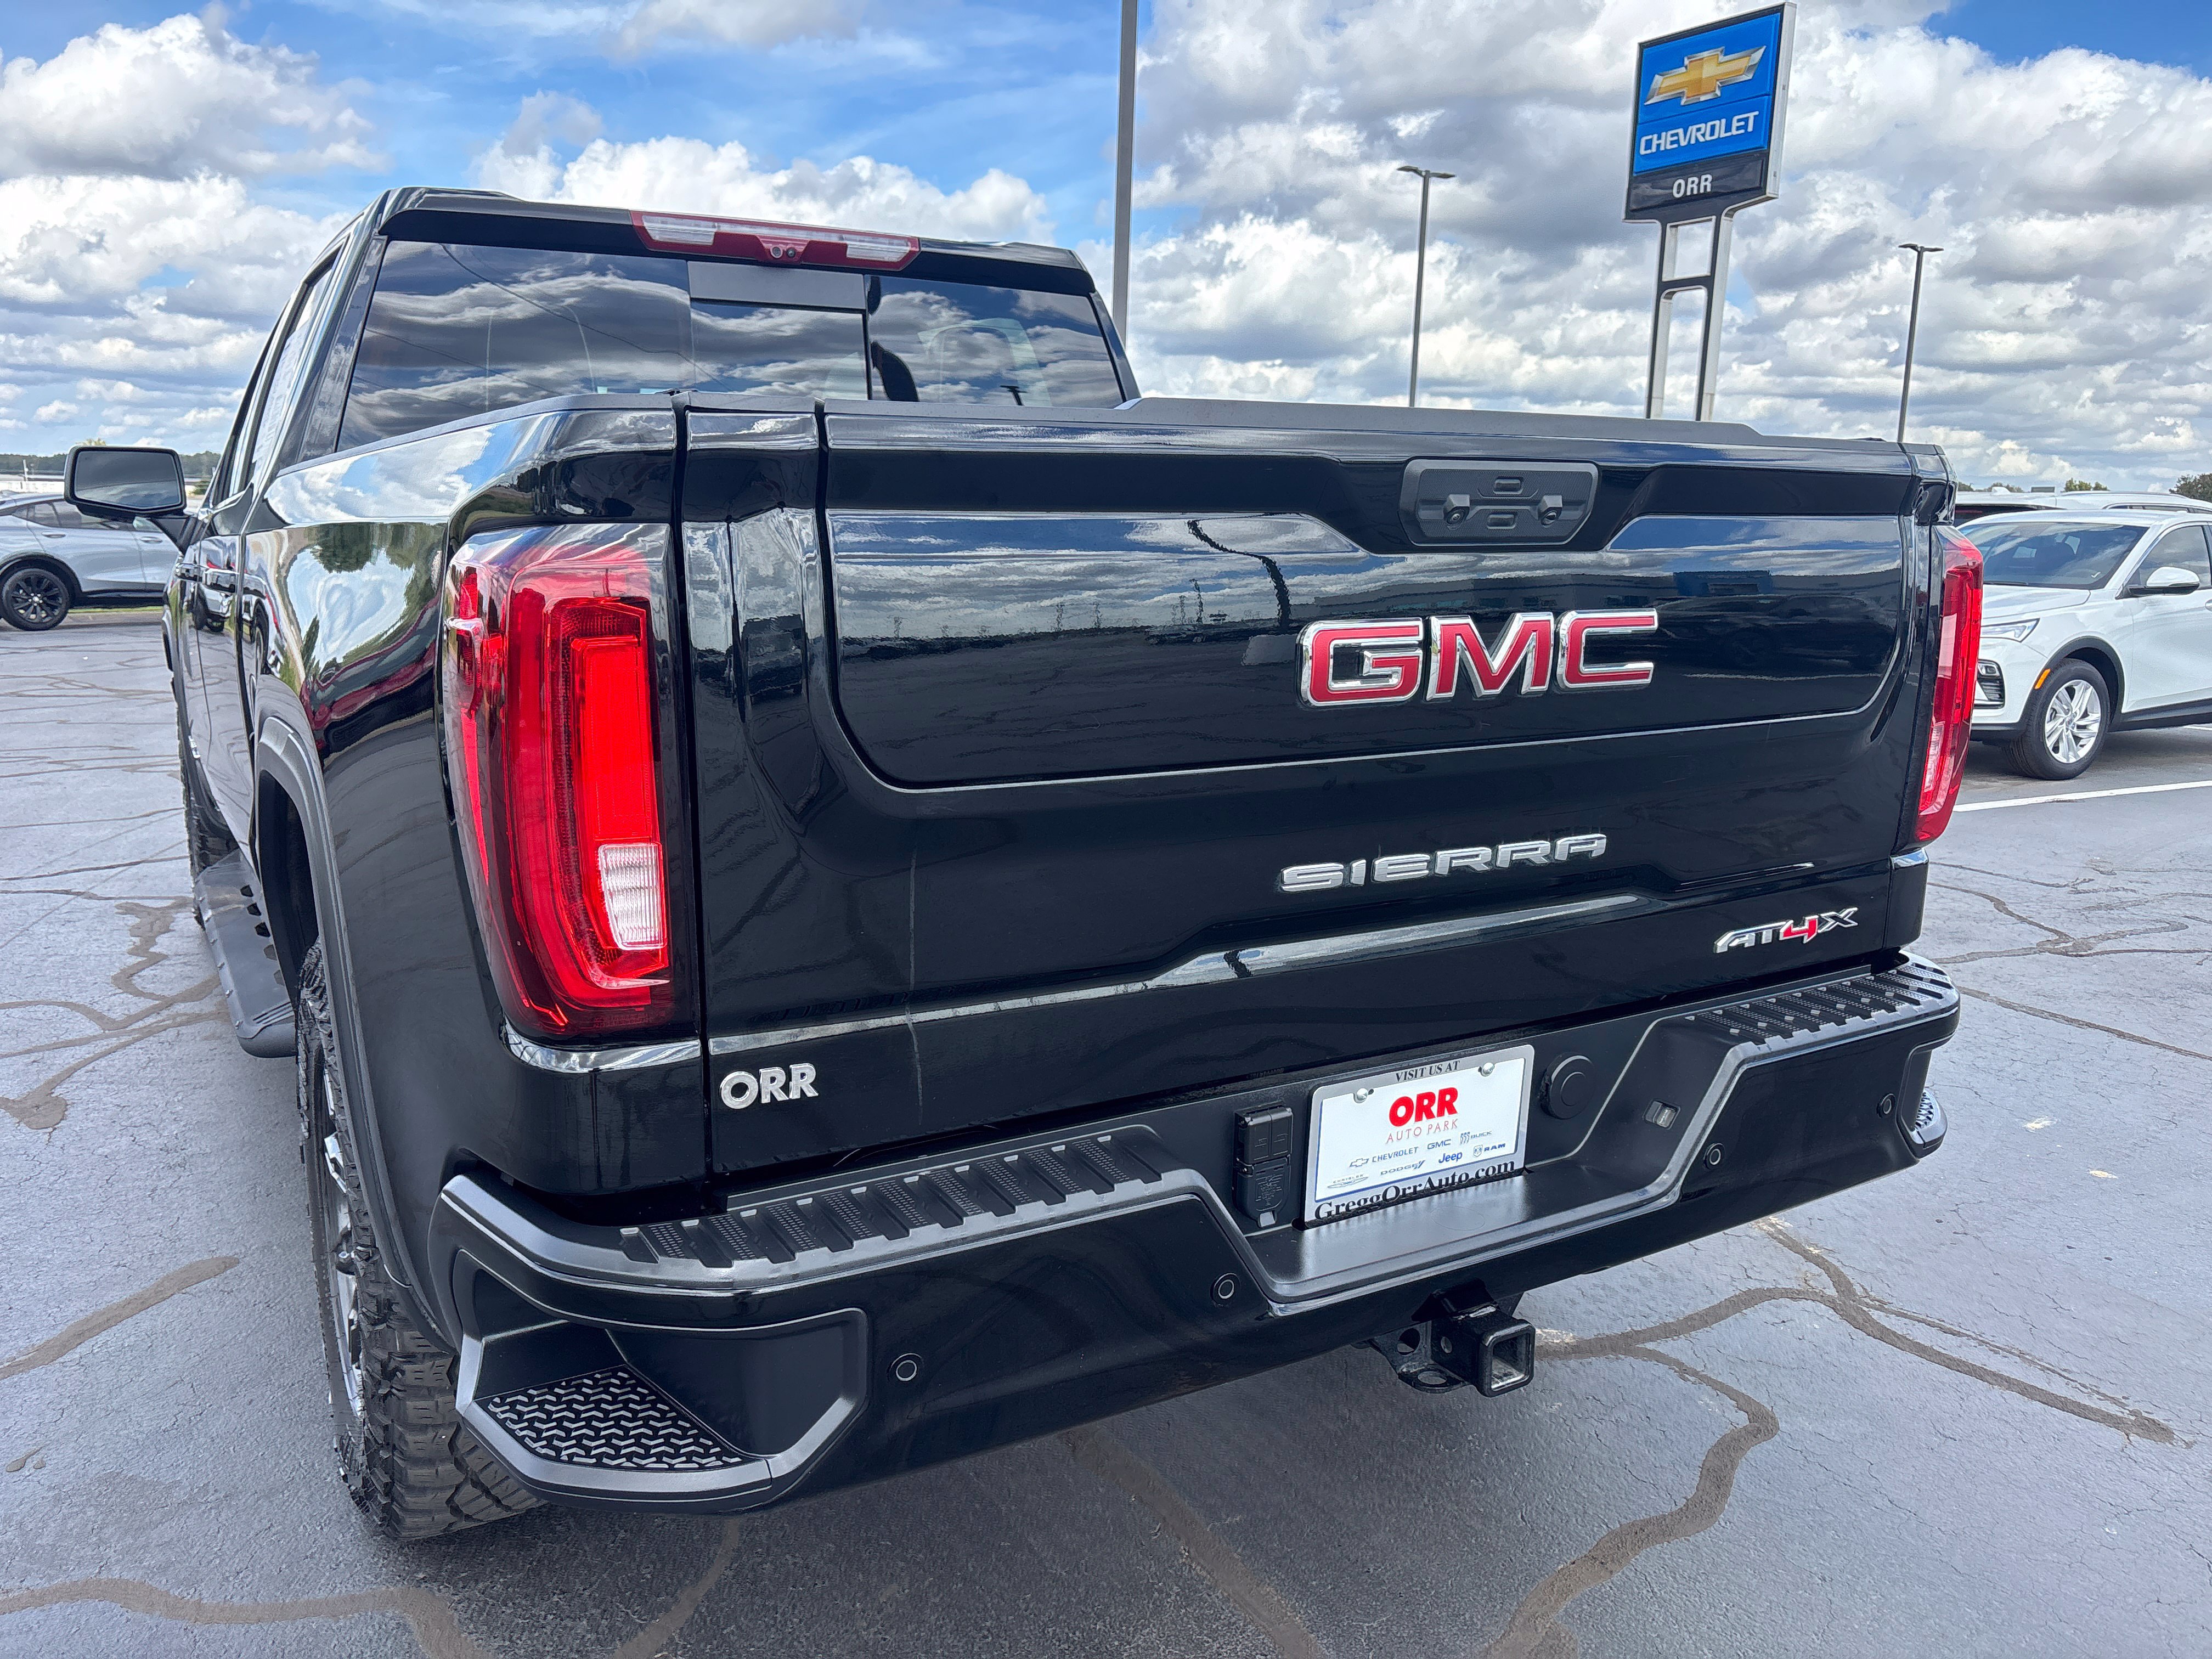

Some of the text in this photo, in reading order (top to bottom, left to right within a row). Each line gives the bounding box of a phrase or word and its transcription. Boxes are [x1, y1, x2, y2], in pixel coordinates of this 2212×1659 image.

[1639, 111, 1759, 155] CHEVROLET
[1672, 174, 1712, 198] ORR
[1299, 608, 1658, 707] GMC
[1280, 833, 1607, 892] SIERRA
[1713, 907, 1859, 953] AT4X
[719, 1063, 819, 1109] ORR
[1395, 1060, 1460, 1082] VISIT US AT
[1389, 1087, 1458, 1127] ORR
[1372, 1130, 1492, 1163] CHEVROLET GMC BUICK
[1385, 1118, 1458, 1144] AUTO PARK
[1380, 1163, 1418, 1175] DODGE
[1438, 1152, 1463, 1164] Jeep
[1483, 1143, 1506, 1152] RAM
[1314, 1160, 1515, 1220] GreggOrrAuto.com
